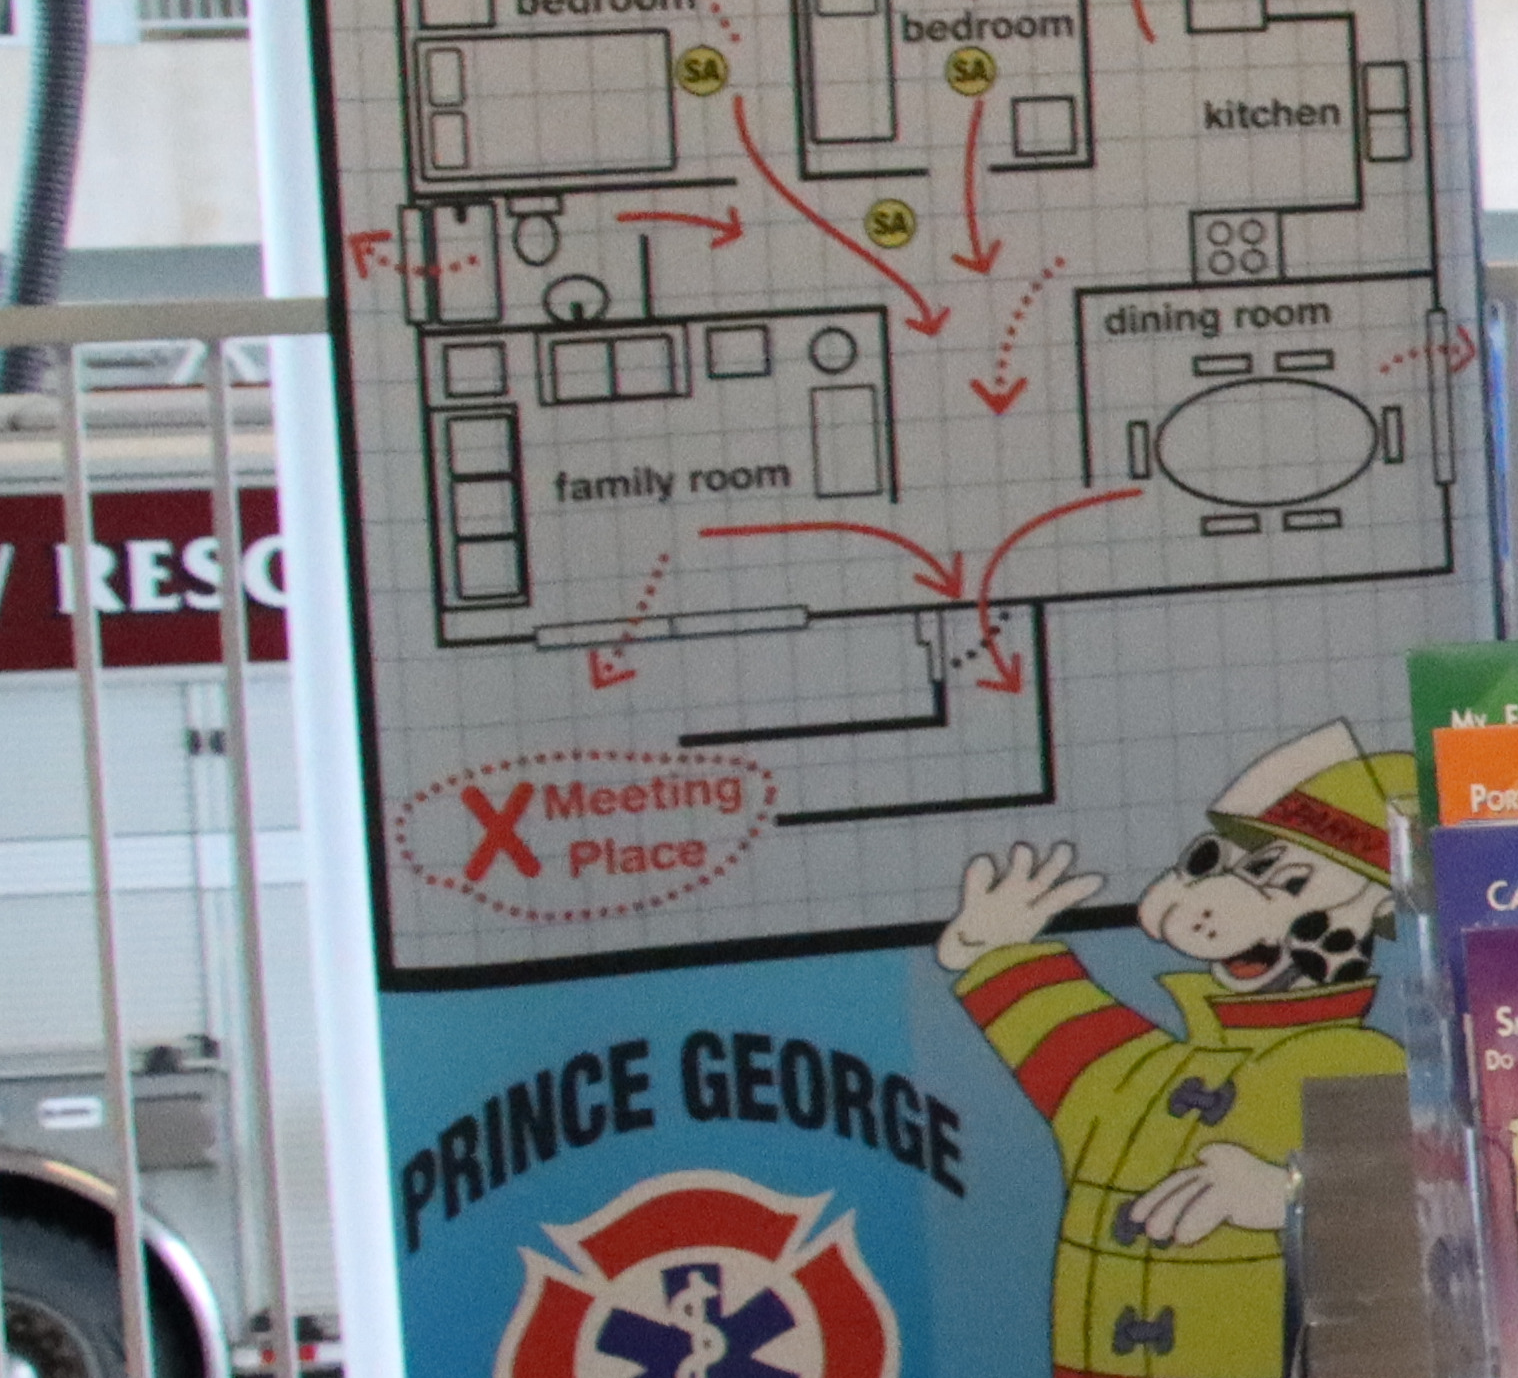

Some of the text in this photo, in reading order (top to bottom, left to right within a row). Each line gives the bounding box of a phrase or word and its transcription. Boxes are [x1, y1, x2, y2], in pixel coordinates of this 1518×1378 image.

[901, 8, 1074, 43] bedroom
[683, 57, 721, 84] SA
[952, 57, 989, 84] SA
[1203, 97, 1340, 130] kitchen
[872, 209, 909, 236] SA
[1104, 298, 1331, 338] dining room
[553, 460, 790, 507] family room
[544, 769, 744, 822] Meeting
[568, 833, 705, 880] Place
[402, 1030, 966, 1251] PRINCE GEORGE
